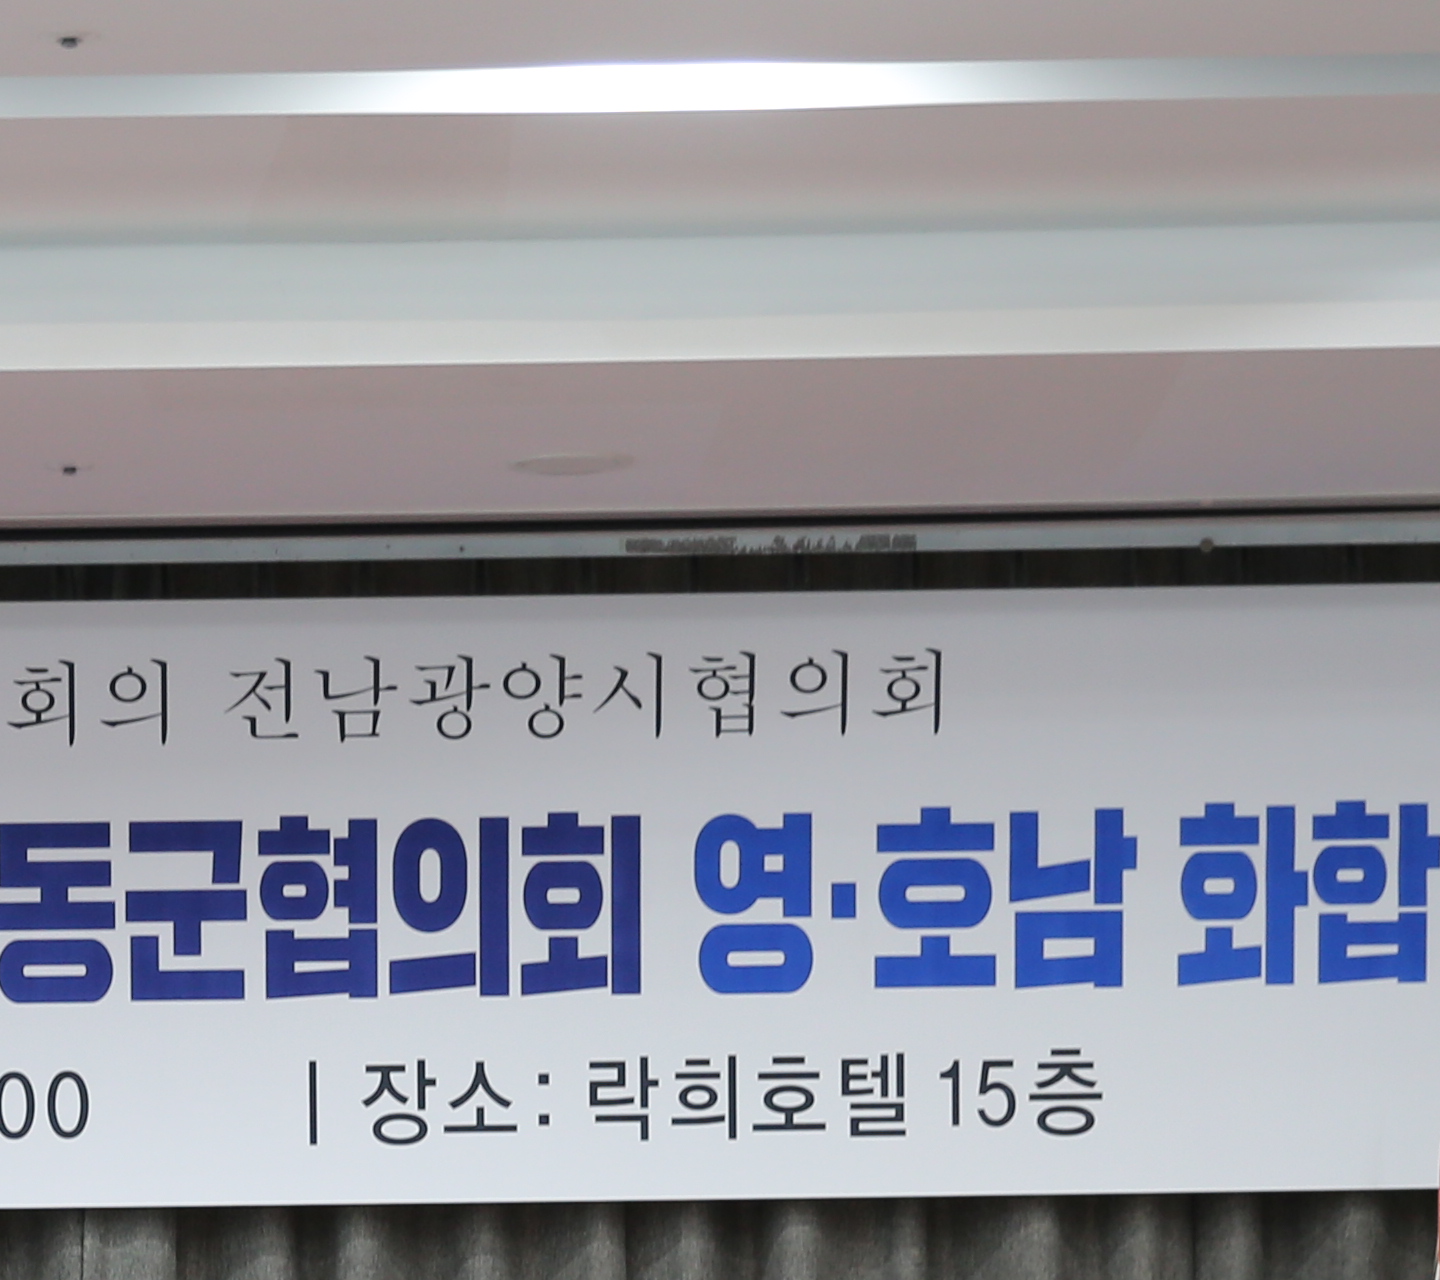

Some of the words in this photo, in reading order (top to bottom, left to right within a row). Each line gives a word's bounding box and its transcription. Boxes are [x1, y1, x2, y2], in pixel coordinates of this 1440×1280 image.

[227, 647, 943, 743] 전남광양시협의회
[588, 1051, 907, 1142] 락희호텔
[939, 1047, 1104, 1137] 15층
